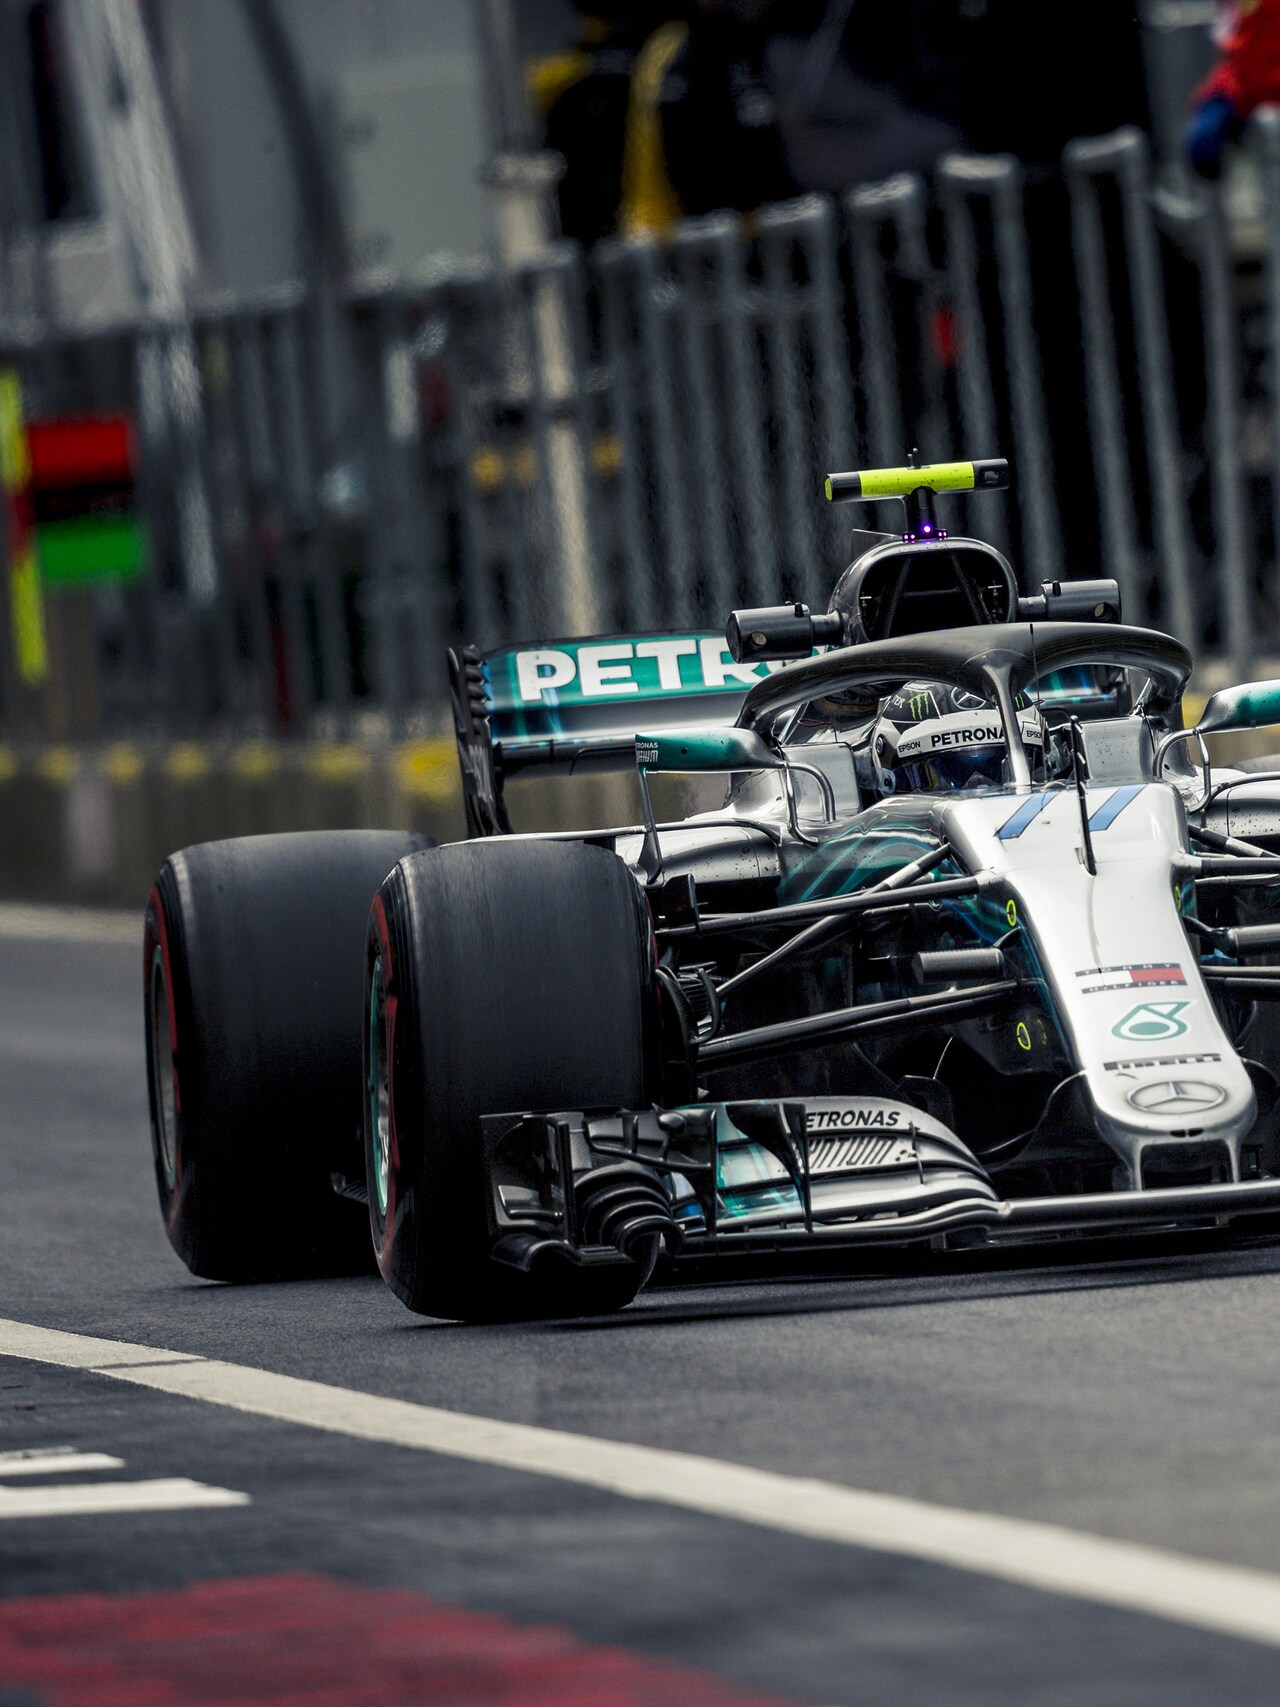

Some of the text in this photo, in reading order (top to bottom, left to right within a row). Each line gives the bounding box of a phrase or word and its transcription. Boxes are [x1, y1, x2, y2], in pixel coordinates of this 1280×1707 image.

[516, 637, 784, 701] PETR
[899, 727, 1005, 753] EPSON PETRON
[1026, 729, 1042, 739] EPSO
[1084, 963, 1171, 975] TOMMY
[1089, 980, 1179, 992] HILFIGER
[806, 1110, 901, 1128] ETRONAS
